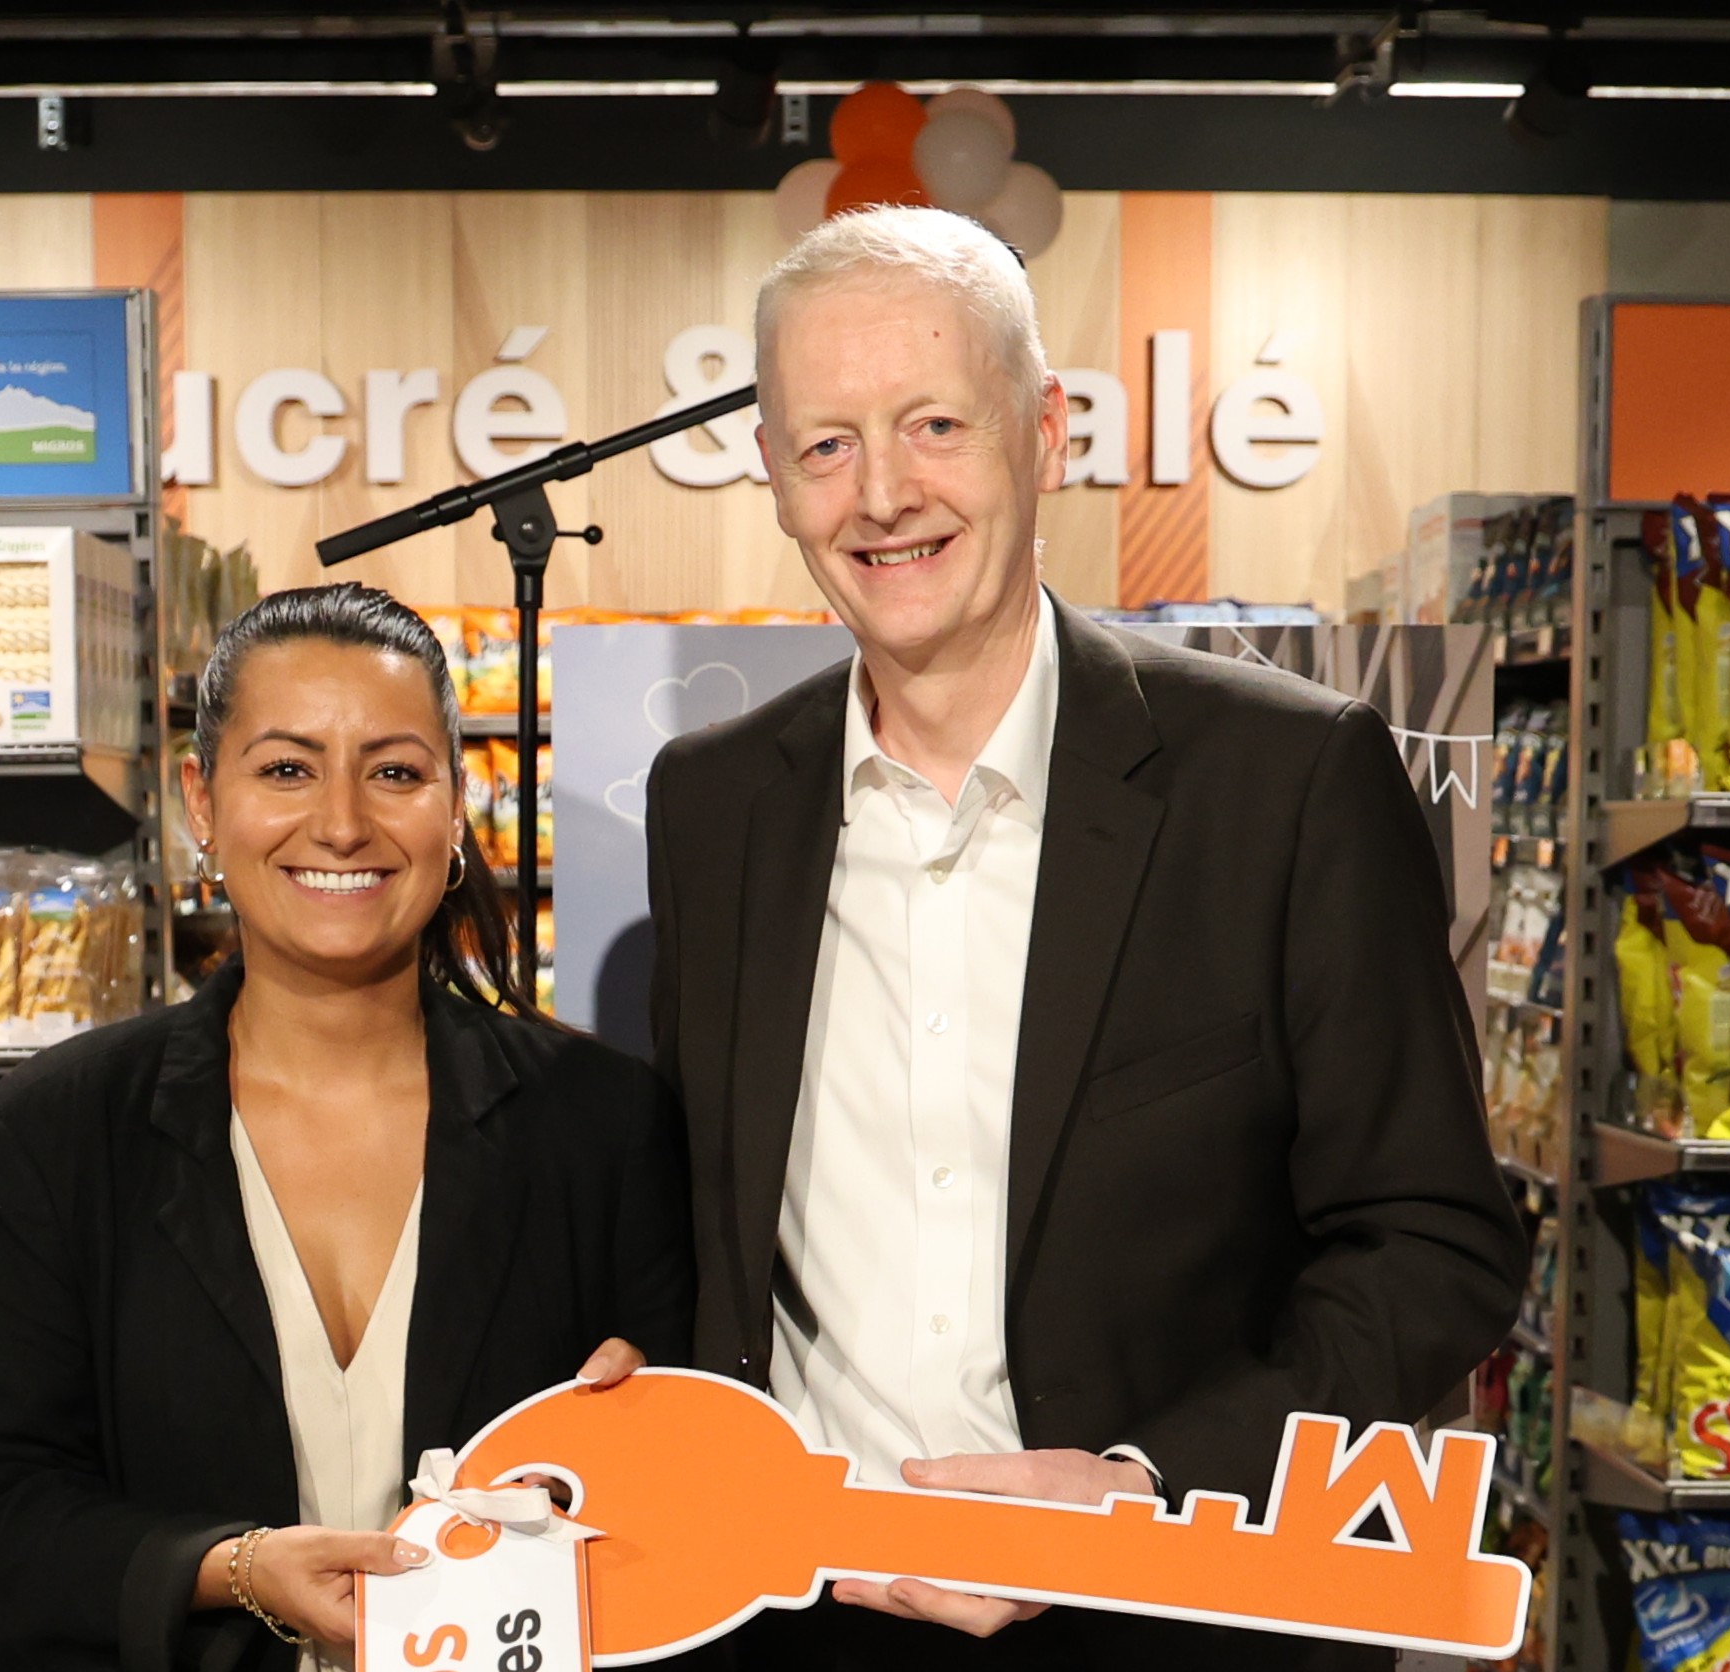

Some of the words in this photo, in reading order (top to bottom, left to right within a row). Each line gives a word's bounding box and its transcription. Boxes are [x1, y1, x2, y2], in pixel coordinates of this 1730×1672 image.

[157, 326, 567, 486] ucré
[1065, 329, 1324, 488] alé
[1621, 1539, 1700, 1583] XXL
